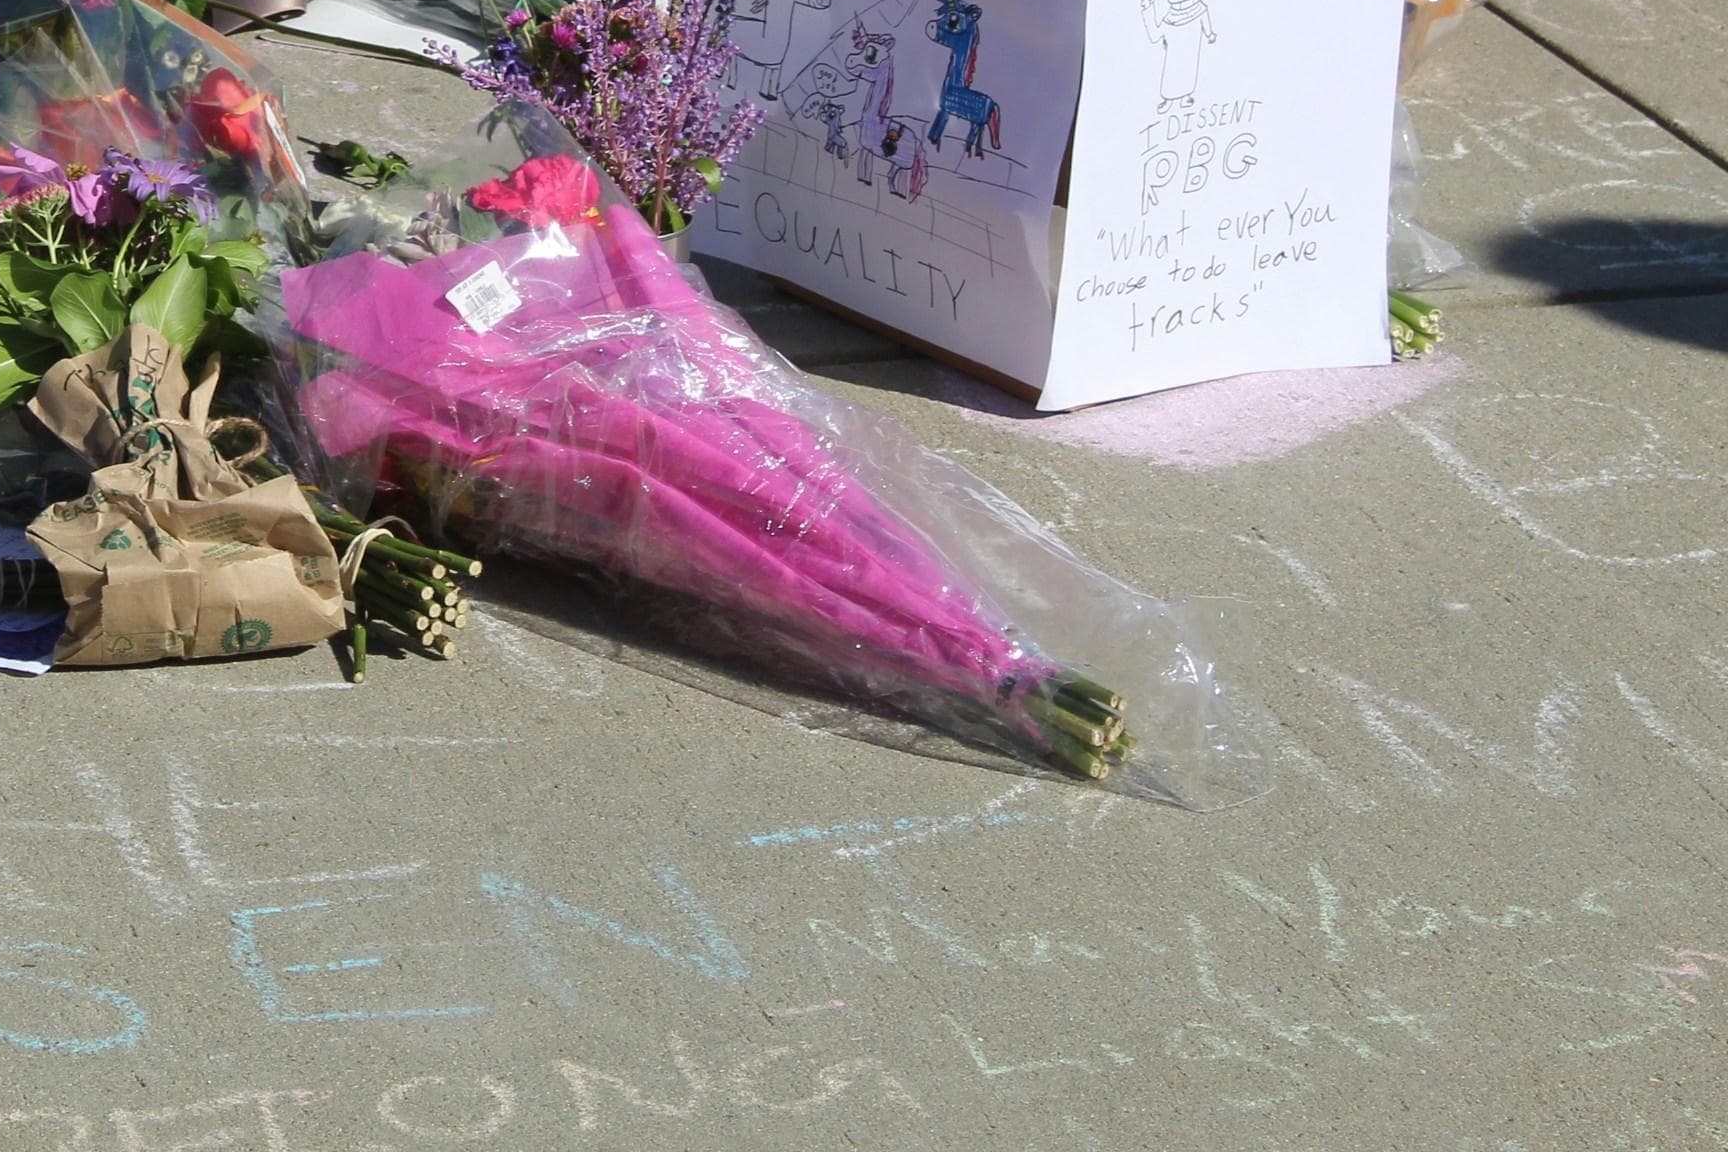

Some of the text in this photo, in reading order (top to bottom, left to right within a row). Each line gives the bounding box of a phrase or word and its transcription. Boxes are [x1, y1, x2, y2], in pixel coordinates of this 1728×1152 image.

[1139, 98, 1263, 157] I DISSENT
[1141, 132, 1259, 216] RBG
[1217, 208, 1275, 241] ever
[1284, 187, 1337, 236] You
[715, 174, 966, 321] EQUALITY
[1252, 240, 1318, 272] leave
